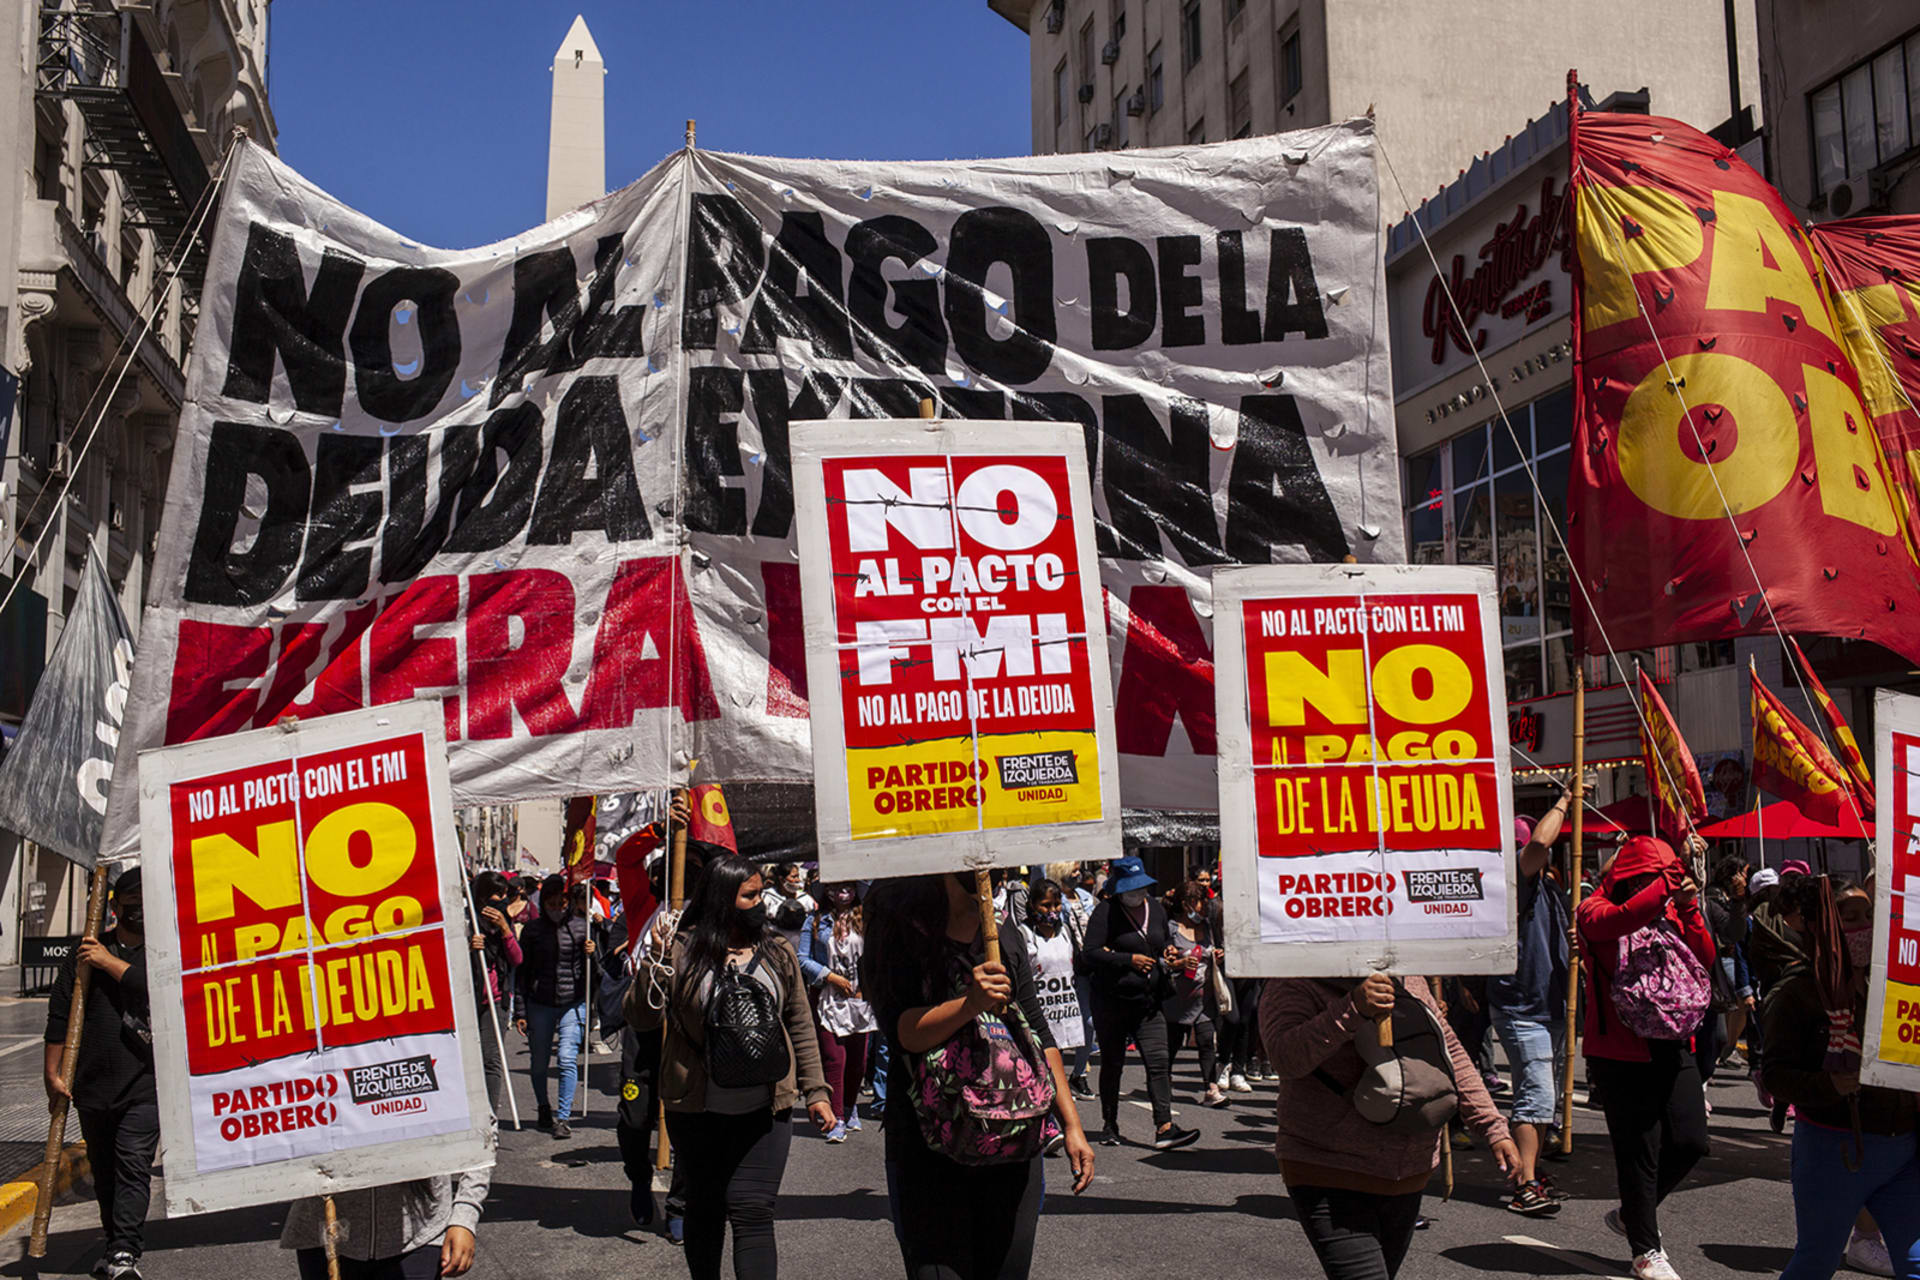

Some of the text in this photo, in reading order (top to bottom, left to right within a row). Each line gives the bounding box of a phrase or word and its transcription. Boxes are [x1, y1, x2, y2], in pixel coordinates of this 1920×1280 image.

[220, 221, 462, 423] NO
[682, 192, 1058, 386] PAGO
[1086, 234, 1206, 350] DE
[1217, 226, 1329, 345] LA
[184, 366, 1351, 606] DEUDA EXNA
[842, 464, 1058, 553] NO
[854, 553, 1065, 598] AL PACTO
[920, 595, 1006, 613] CON EL
[1261, 605, 1466, 637] NO AL PACTO CON EL FMI
[164, 554, 720, 745] FUERA
[855, 613, 1072, 686] FMI
[1264, 643, 1473, 727] NO
[858, 683, 1075, 727] NO AL PAGO DE LA DEUDA
[1002, 754, 1068, 770] FRENTE DE
[1272, 730, 1478, 770] AL PAGO
[188, 749, 408, 823] NO AL PACTO CON EL FMI
[867, 759, 988, 789] PARTIDO
[1003, 766, 1074, 784] IZQUIERDA
[874, 785, 986, 815] OBRERO
[1017, 788, 1063, 802] UNIDAD
[1275, 773, 1485, 835] DE LA DEUDA
[191, 801, 417, 924] NO
[1410, 871, 1474, 884] FRENTE DE
[1279, 872, 1397, 895] PARTIDO
[1411, 883, 1479, 897] IZQUIERDA
[1285, 896, 1394, 919] OBRERO
[1424, 903, 1468, 914] UNIDAD
[201, 895, 424, 974] AL PAGO
[43, 945, 71, 957] MOS
[1898, 937, 1918, 966] NO
[203, 945, 435, 1048] DE LA DEUDA
[353, 1061, 426, 1083] FRENTE DE
[355, 1073, 433, 1097] IZQUIERDA
[212, 1073, 338, 1117] PARTIDO
[371, 1097, 422, 1116] UNIDAD
[220, 1101, 337, 1142] OBRERO
